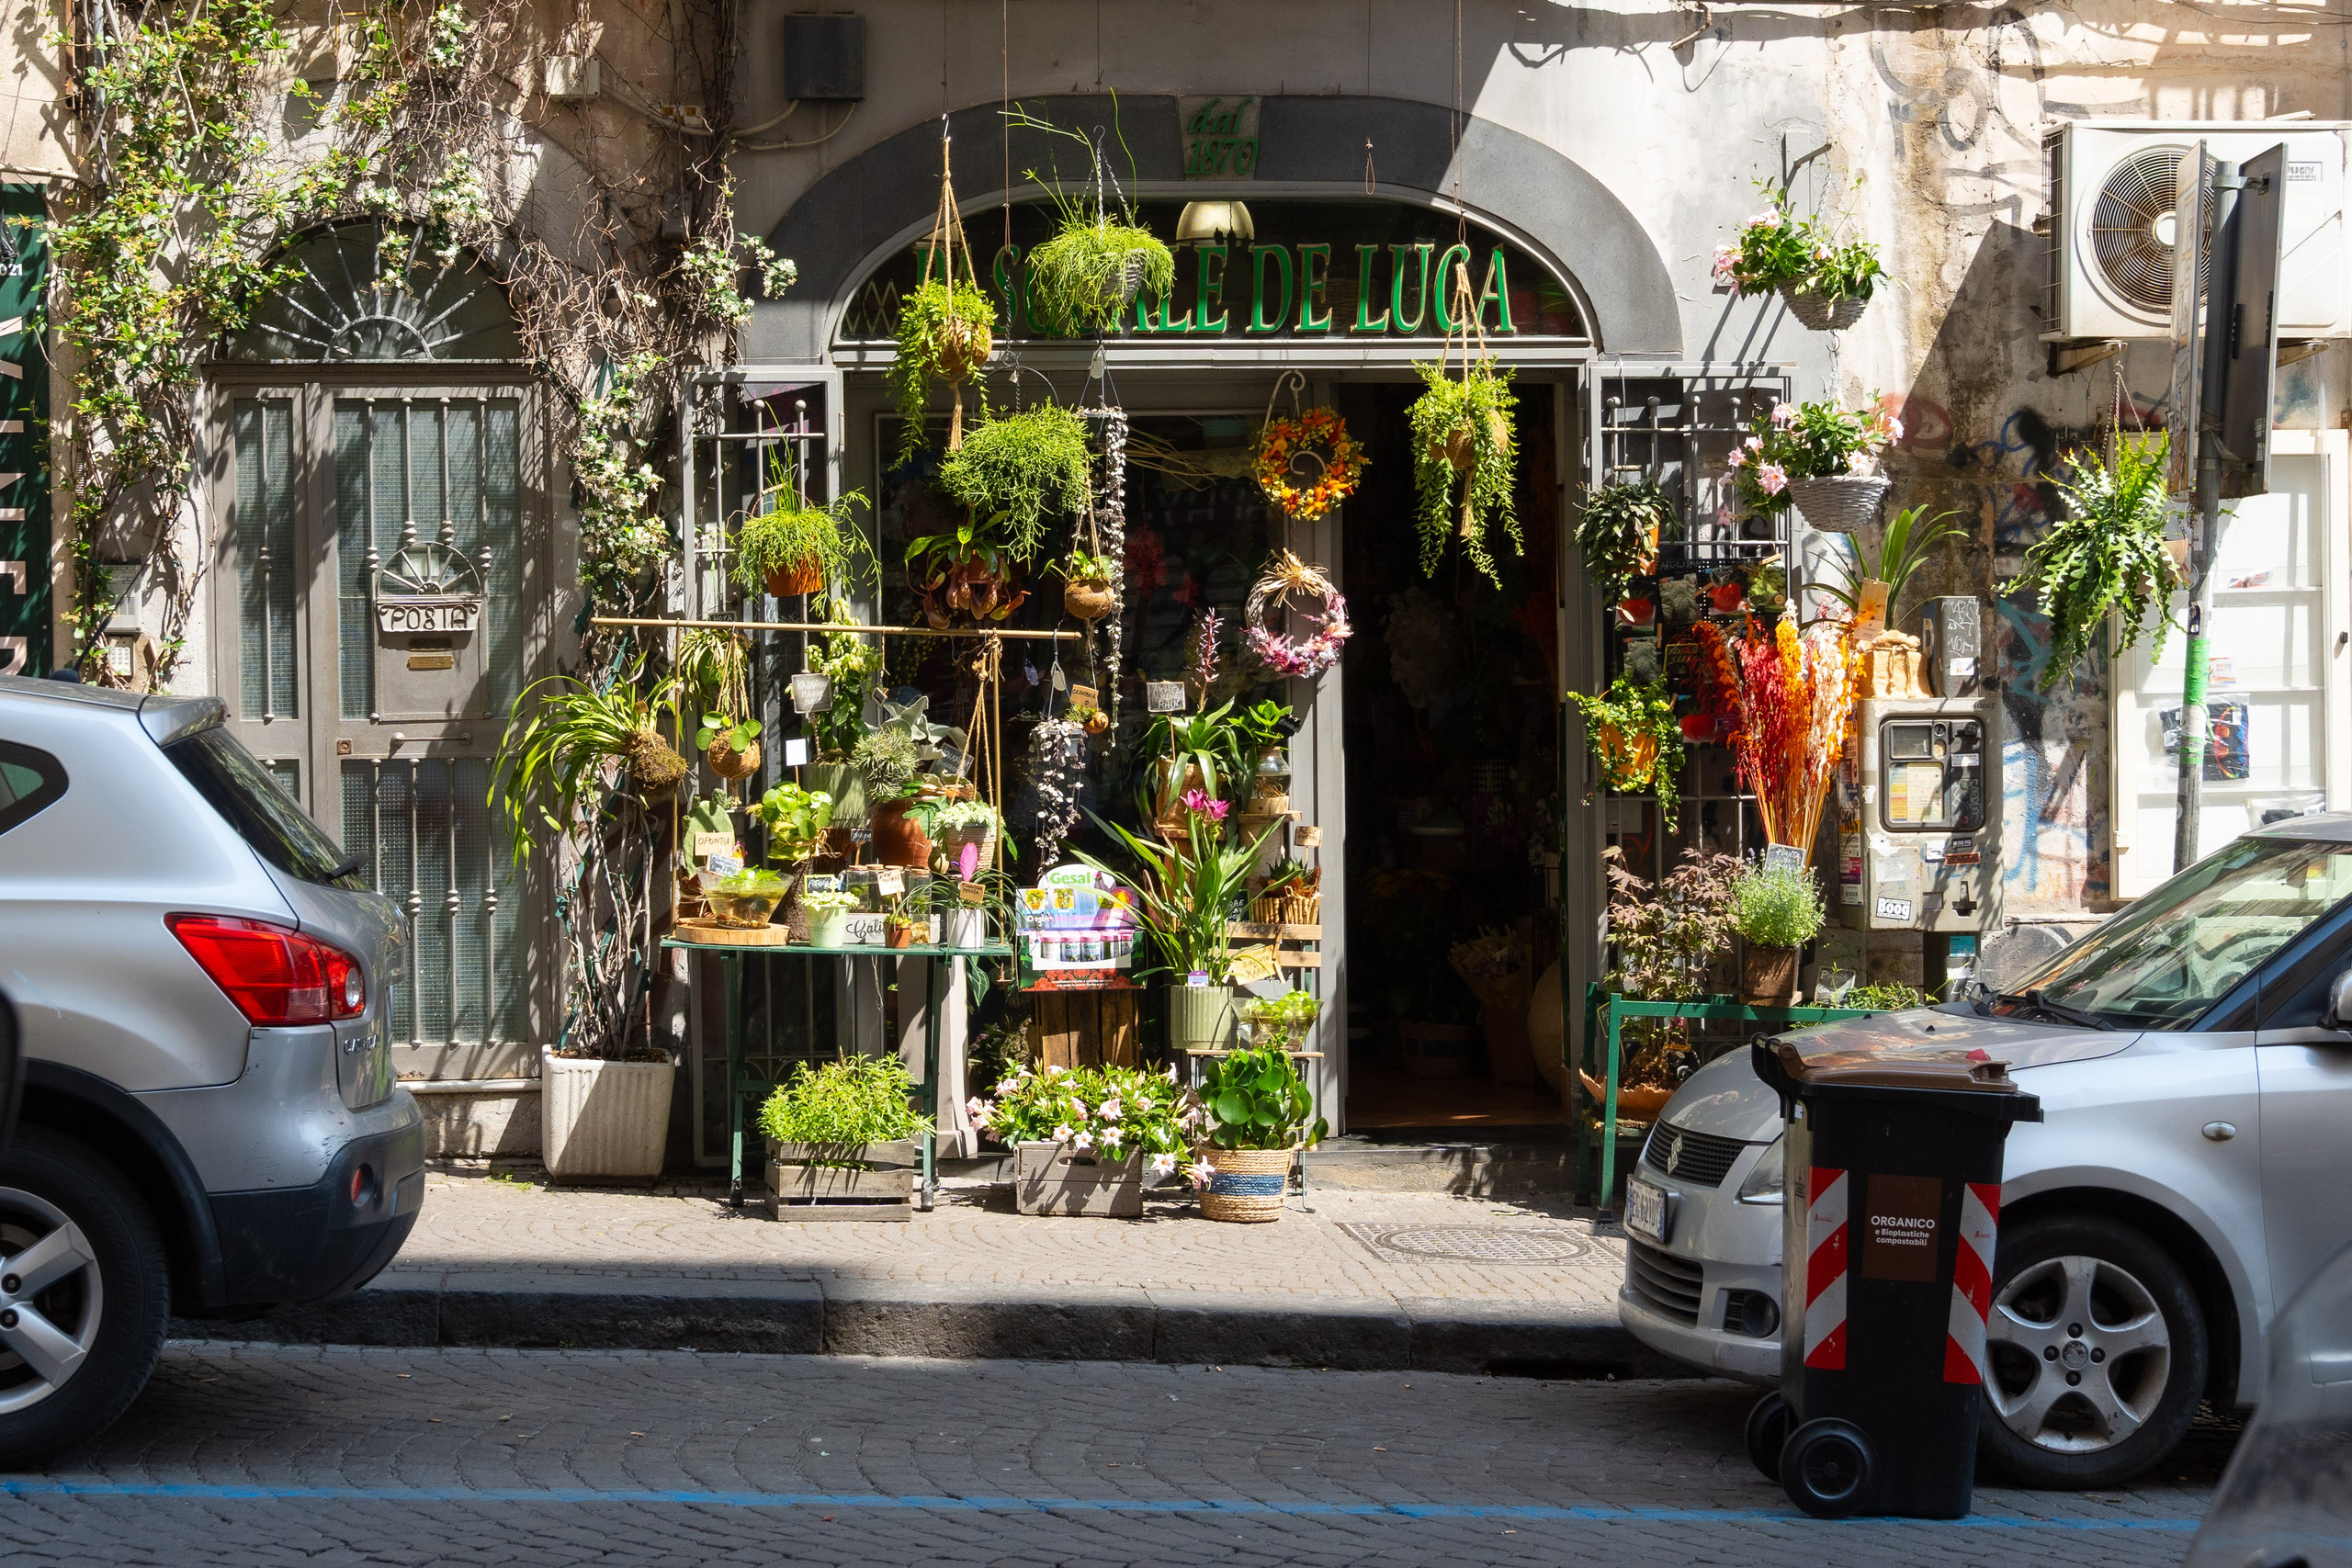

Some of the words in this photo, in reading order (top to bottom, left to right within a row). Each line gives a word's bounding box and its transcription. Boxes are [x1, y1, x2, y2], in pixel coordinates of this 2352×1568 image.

[1188, 97, 1253, 134] dal
[1184, 138, 1258, 175] 1870
[1245, 243, 1332, 333] DE
[1350, 243, 1517, 333] LUCA
[698, 837, 730, 845] OPUNTIA
[1049, 872, 1091, 885] Gesal
[1877, 897, 1910, 920] Boog
[1871, 1215, 1935, 1229] ORGANICO
[1882, 1228, 1929, 1238] Bioplastiche
[1876, 1236, 1928, 1247] compostabili
